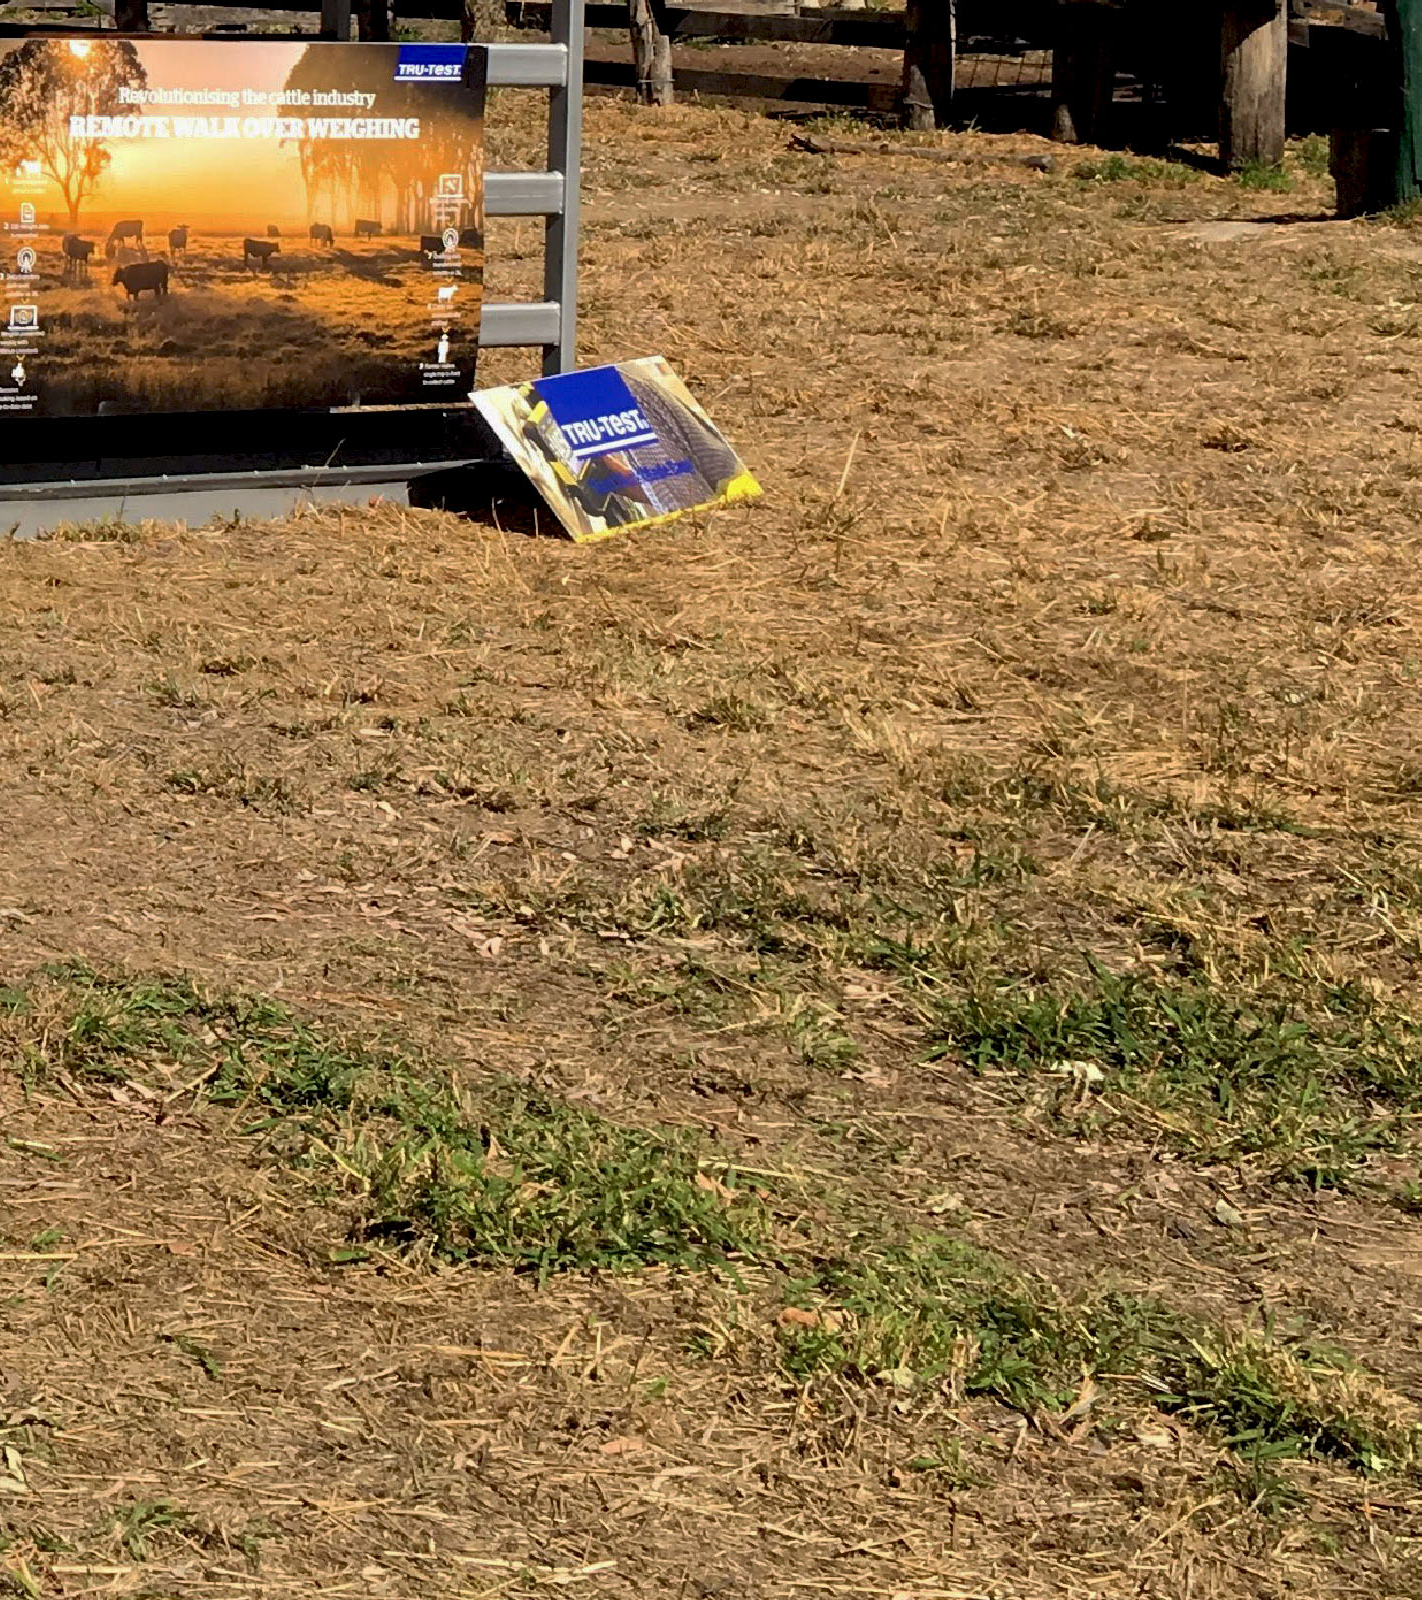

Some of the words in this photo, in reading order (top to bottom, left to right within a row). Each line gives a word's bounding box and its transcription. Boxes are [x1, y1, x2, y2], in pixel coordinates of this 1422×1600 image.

[118, 86, 240, 108] Revolutionising
[242, 87, 267, 105] the
[268, 88, 311, 106] cattle
[312, 88, 377, 109] industry
[69, 115, 170, 138] REMOTE
[171, 116, 242, 139] WALK
[243, 117, 304, 139] OVER
[306, 117, 421, 139] WEIGHING
